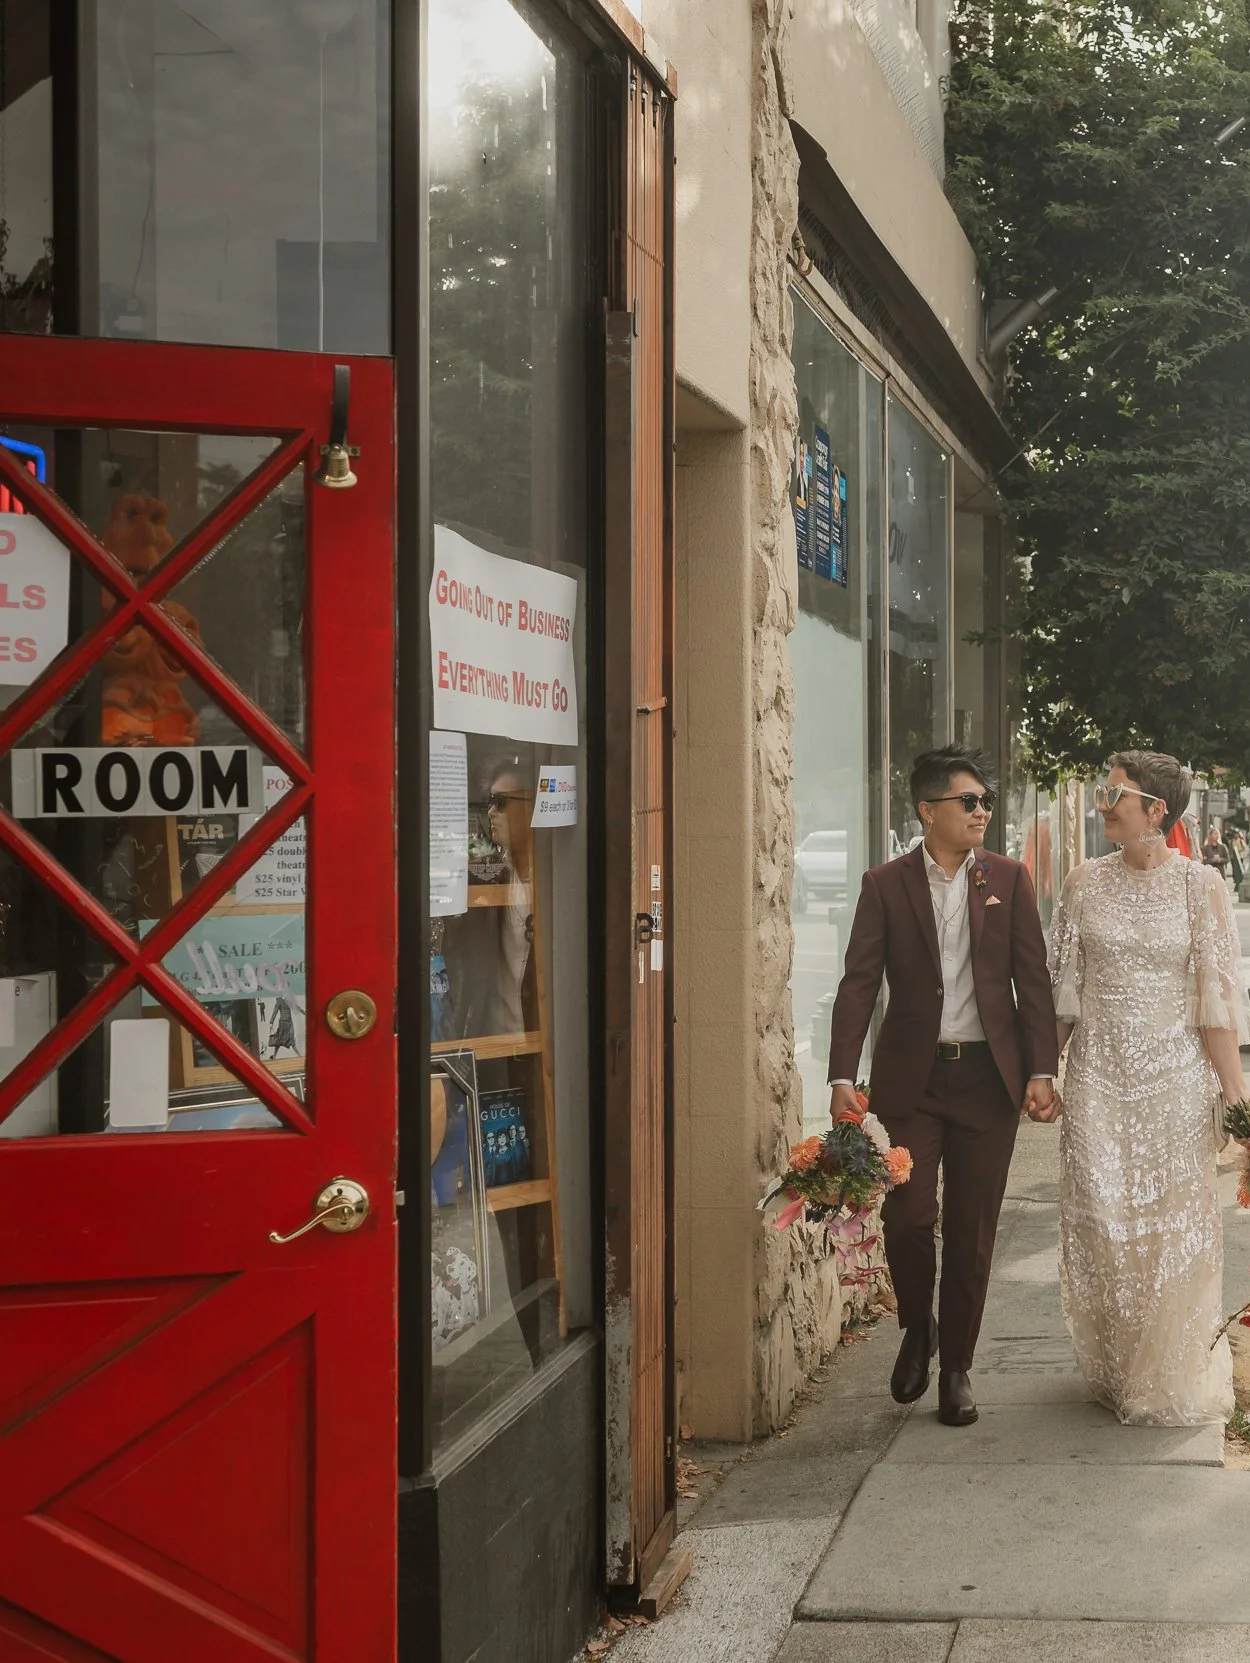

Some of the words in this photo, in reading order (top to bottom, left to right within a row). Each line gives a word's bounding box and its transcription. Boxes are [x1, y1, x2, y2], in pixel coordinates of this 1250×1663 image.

[42, 749, 249, 813] ROOM
[178, 818, 224, 840] TÁR
[255, 874, 274, 884] $25
[276, 874, 301, 886] vinyl
[255, 888, 273, 898] $25
[276, 887, 297, 897] Star
[218, 942, 263, 958] SALE
[481, 1107, 520, 1121] GUCCI
